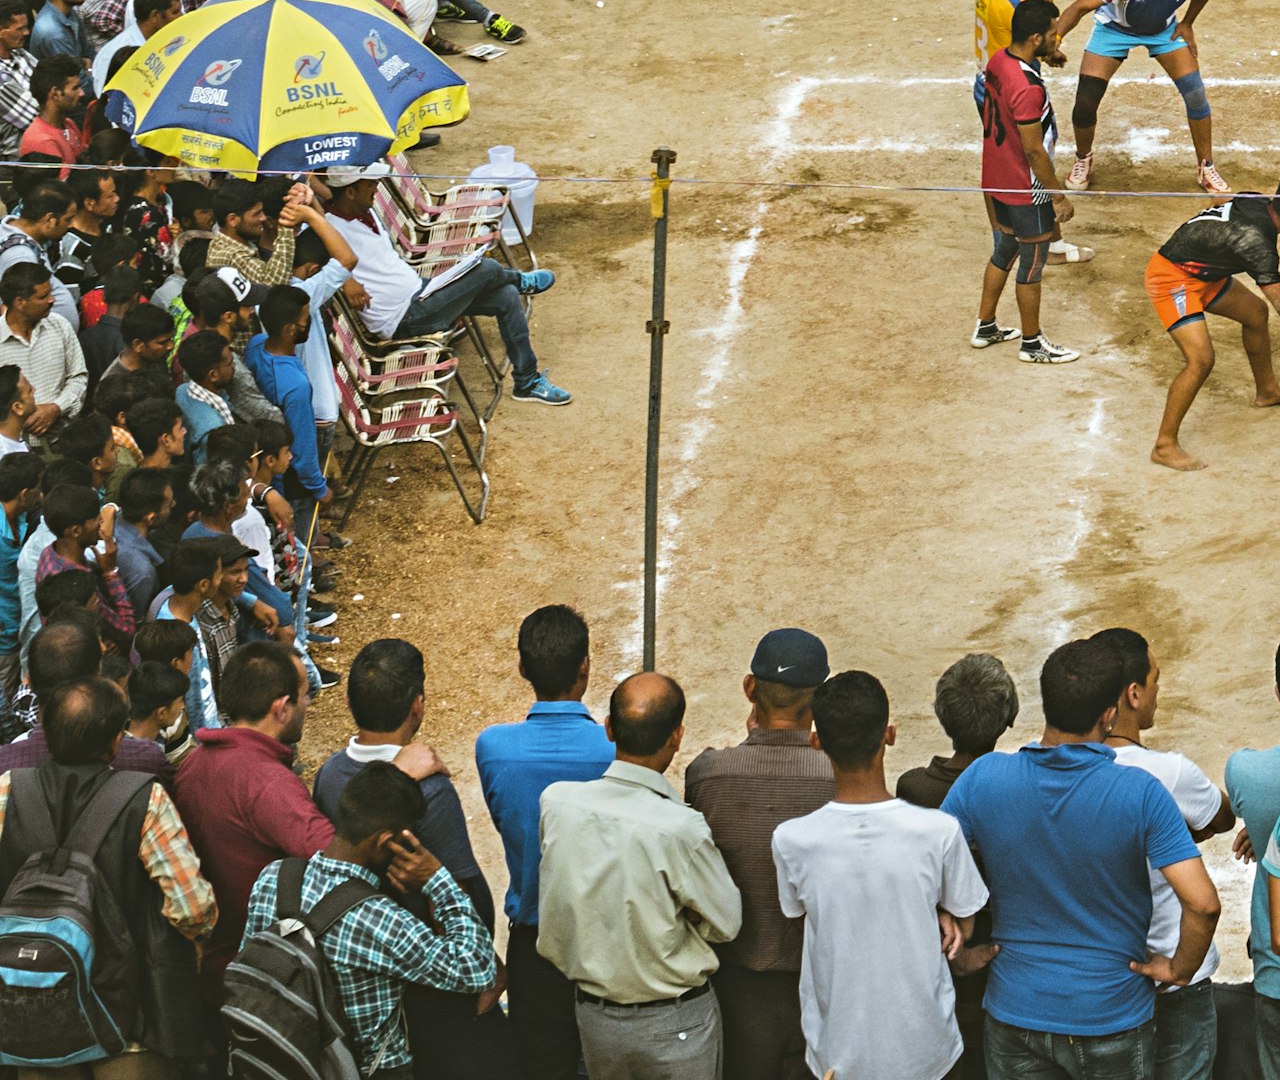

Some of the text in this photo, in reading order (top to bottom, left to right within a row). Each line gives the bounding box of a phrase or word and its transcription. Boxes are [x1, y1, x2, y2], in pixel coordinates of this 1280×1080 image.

[144, 53, 167, 82] BSNL
[378, 56, 410, 83] BSNL
[190, 86, 229, 107] BSNL
[287, 84, 343, 105] BSNL
[275, 97, 348, 118] Connecting India
[304, 137, 358, 154] LOWEST
[305, 150, 351, 166] TARIFF
